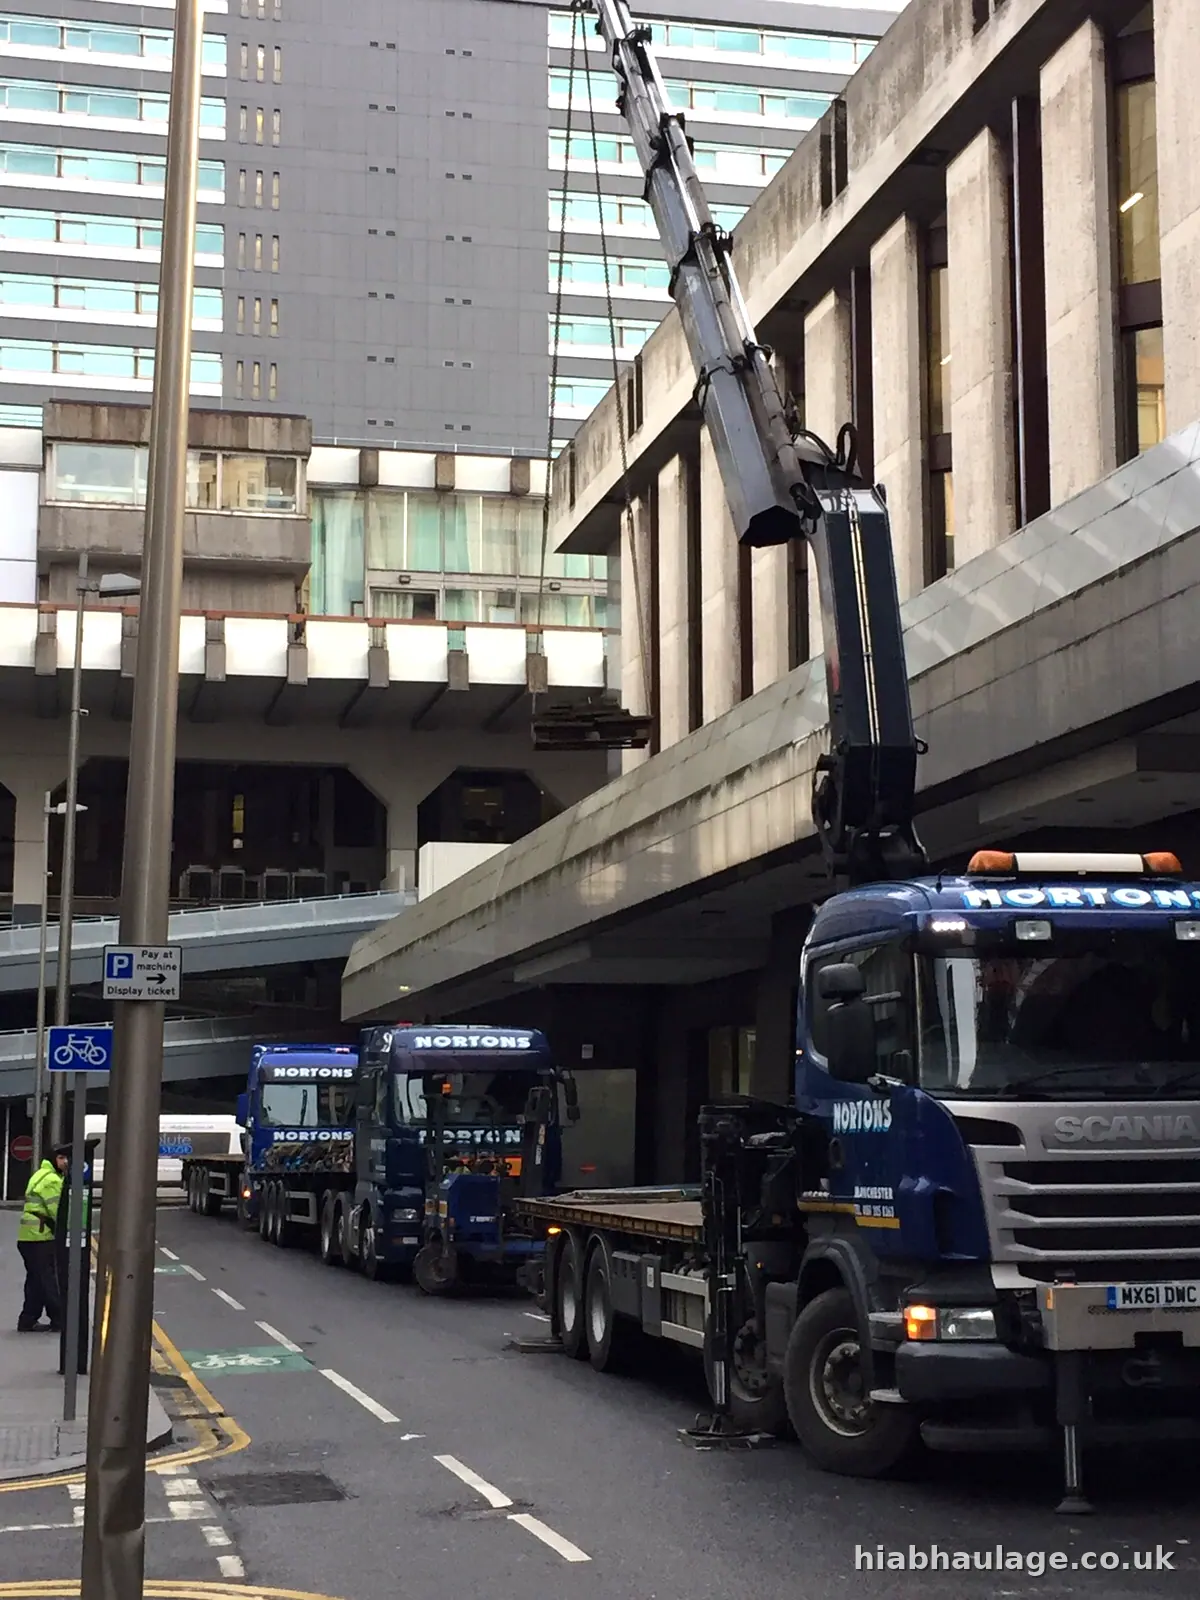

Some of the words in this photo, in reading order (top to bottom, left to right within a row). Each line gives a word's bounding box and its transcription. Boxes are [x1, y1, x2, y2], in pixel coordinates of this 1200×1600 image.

[141, 949, 159, 960] Pay
[163, 950, 173, 959] at
[136, 962, 178, 971] machine
[107, 986, 143, 997] Display
[147, 987, 176, 996] ticket
[414, 1035, 532, 1049] NORTONS
[274, 1067, 353, 1078] NORTONS
[832, 1099, 892, 1133] NORTONS
[1054, 1115, 1200, 1143] SCANIA
[273, 1131, 354, 1141] NORTONS
[418, 1129, 521, 1145] NORTON
[1122, 1286, 1160, 1304] MX61
[1164, 1286, 1197, 1303] DWC
